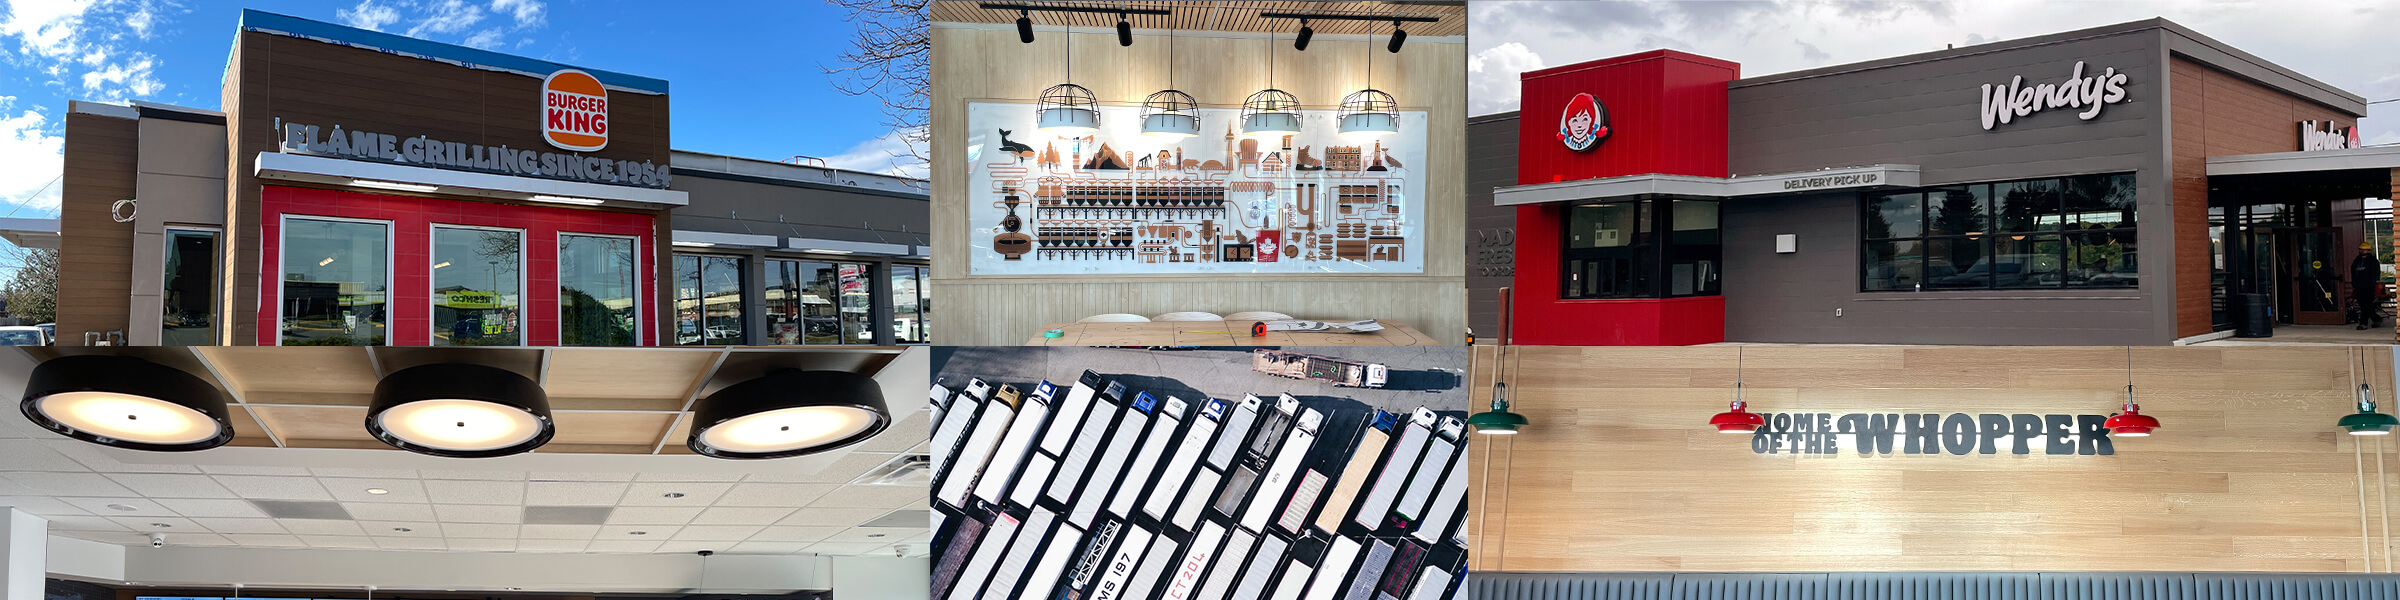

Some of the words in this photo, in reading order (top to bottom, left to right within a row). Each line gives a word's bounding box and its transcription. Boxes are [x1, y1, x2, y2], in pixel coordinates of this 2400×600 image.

[548, 92, 606, 113] BURGER
[1981, 60, 2128, 130] Wendy's
[548, 108, 606, 134] KING
[285, 122, 398, 159] FLAME
[402, 137, 538, 173] GRILLING
[540, 152, 615, 182] SINCE
[616, 160, 672, 187] 1954
[1784, 176, 1832, 190] DELIVERY
[1834, 175, 1861, 186] PICK
[1862, 173, 1877, 183] UP
[1755, 413, 1831, 433] HOME
[1837, 412, 2115, 455] WHOPPER
[1752, 433, 1783, 454] OF
[1787, 433, 1838, 454] THE
[1113, 552, 1131, 577] 197
[1183, 553, 1205, 580] 204
